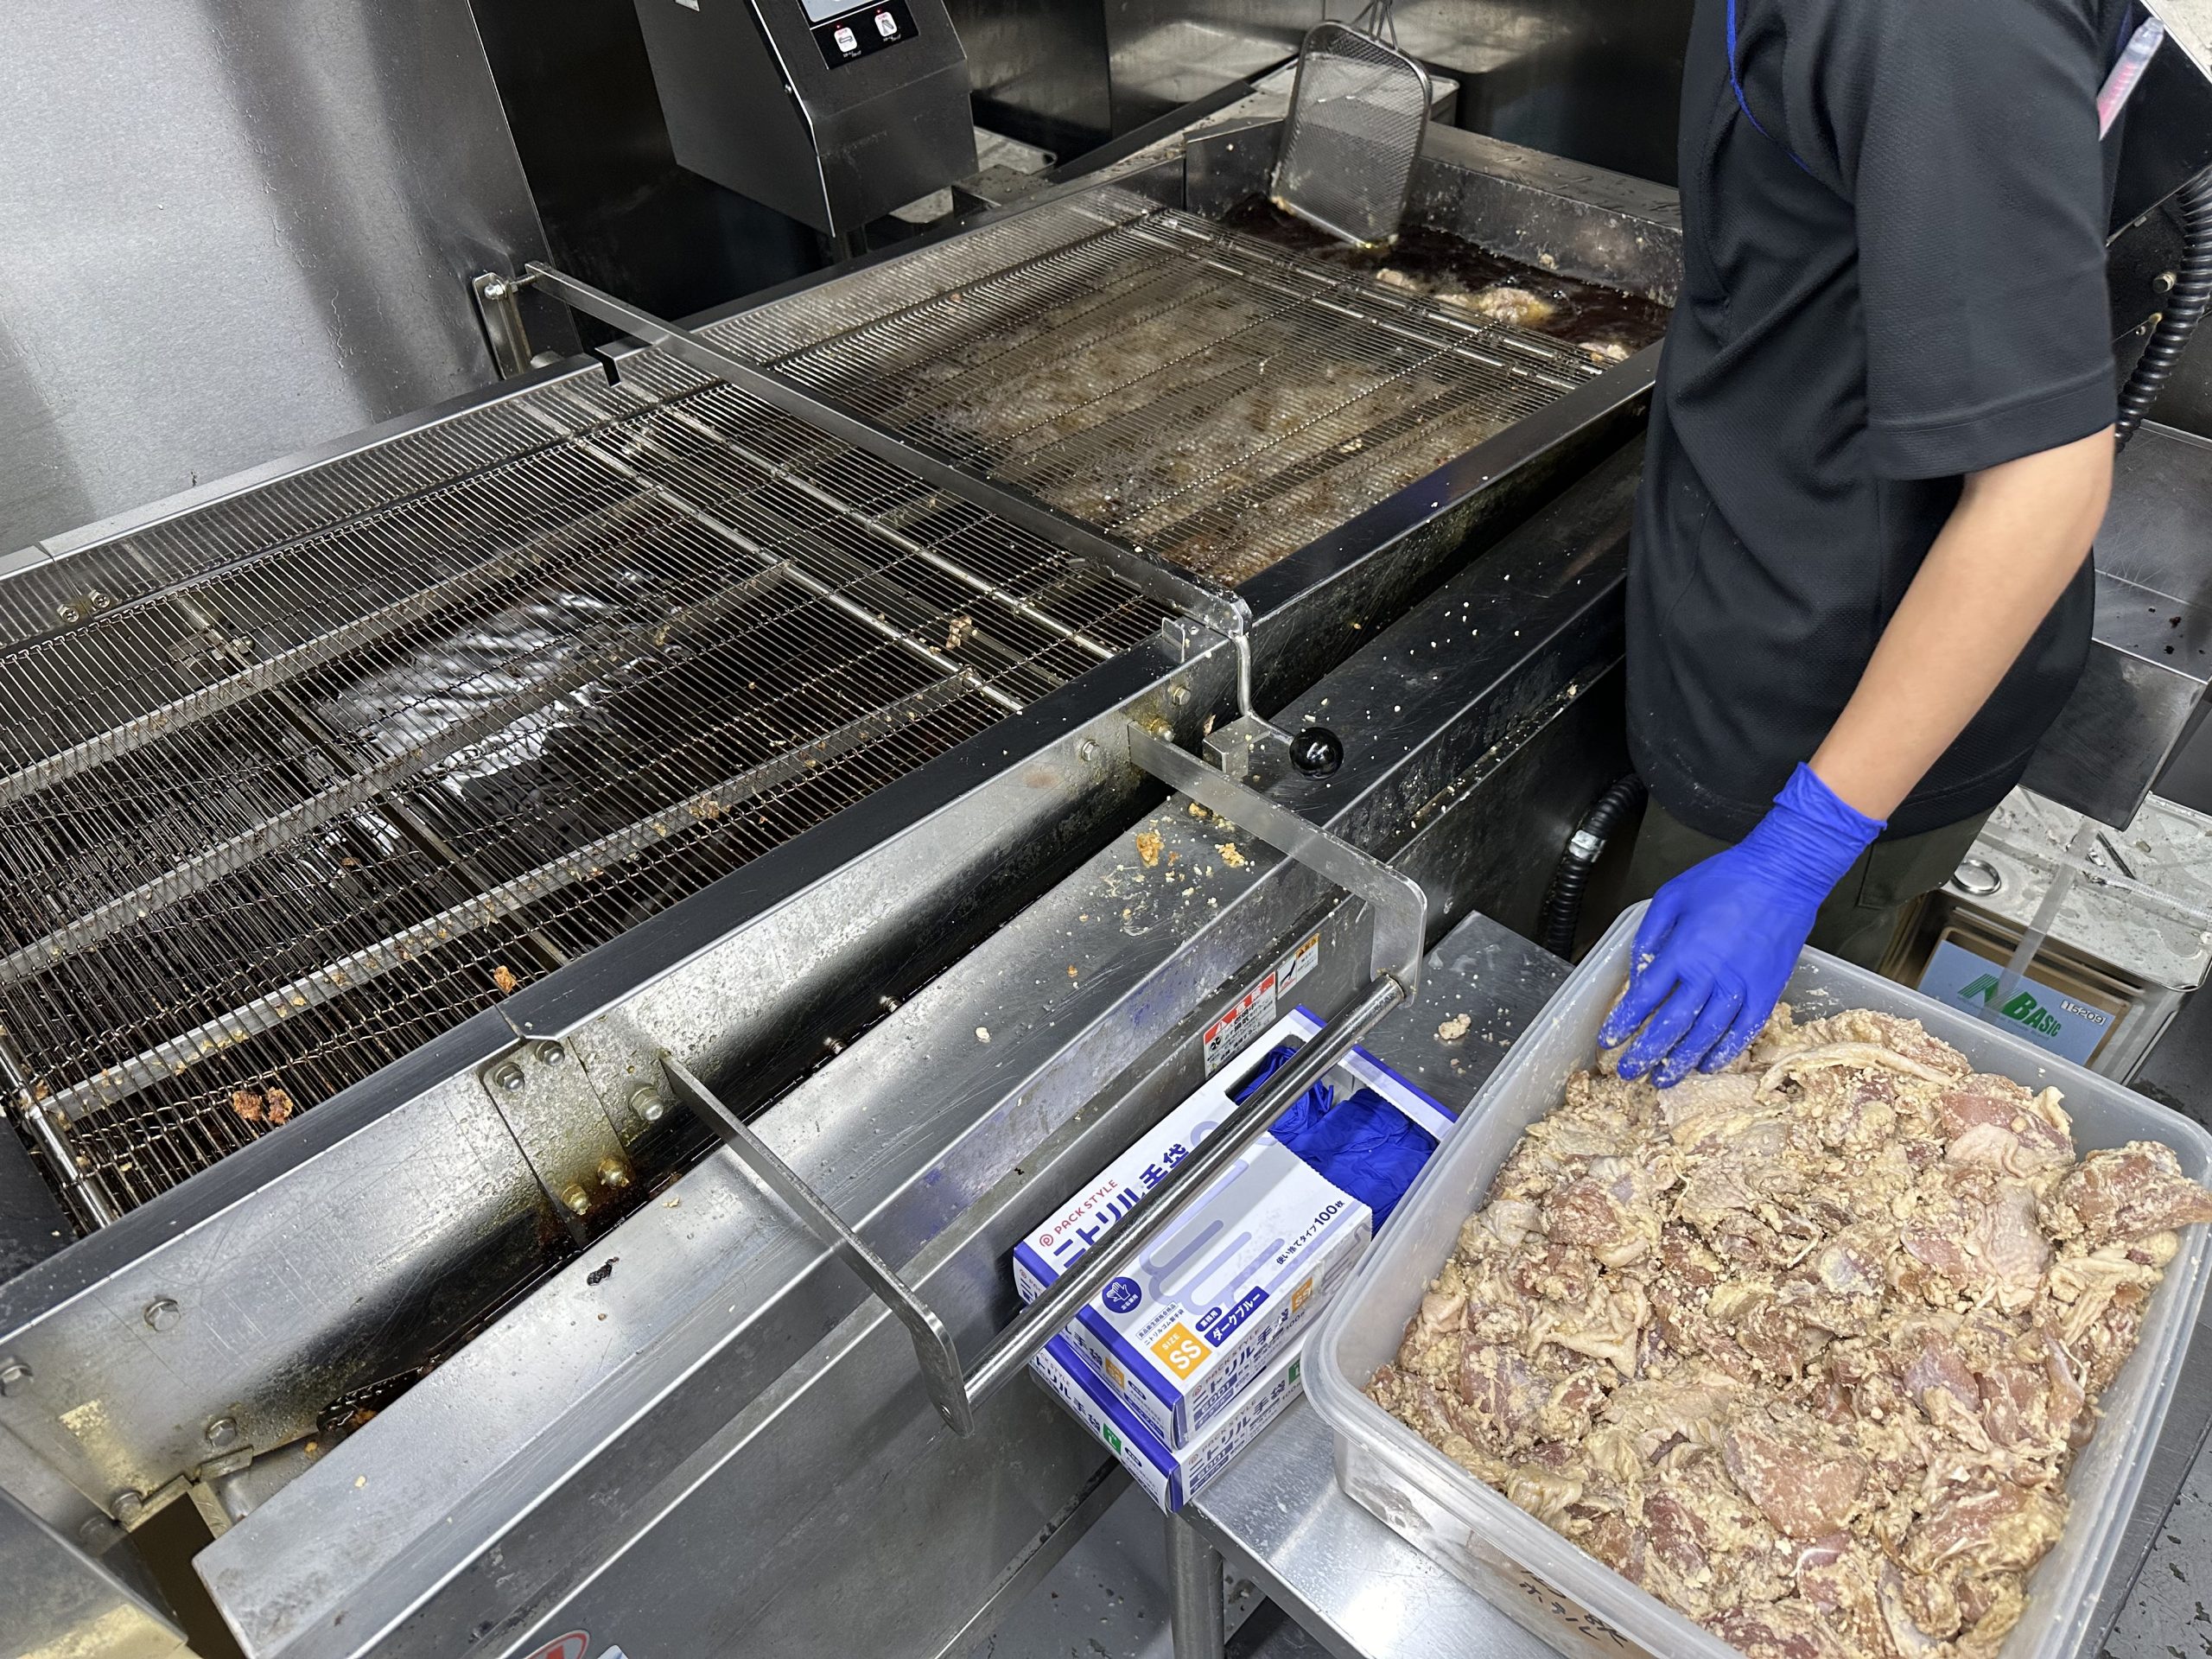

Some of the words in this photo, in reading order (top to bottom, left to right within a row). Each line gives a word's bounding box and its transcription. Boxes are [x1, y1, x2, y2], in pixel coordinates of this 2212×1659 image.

[2064, 1001, 2104, 1024] 15209
[1053, 1207, 1085, 1235] PACK
[1084, 1179, 1118, 1210] STYLE
[1212, 1294, 1261, 1341] ダークブルー
[1161, 1332, 1181, 1351] SIZE
[1169, 1339, 1202, 1370] SS
[1030, 1356, 1101, 1433] トリル手袋
[1189, 1380, 1286, 1478] ニトリル手袋
